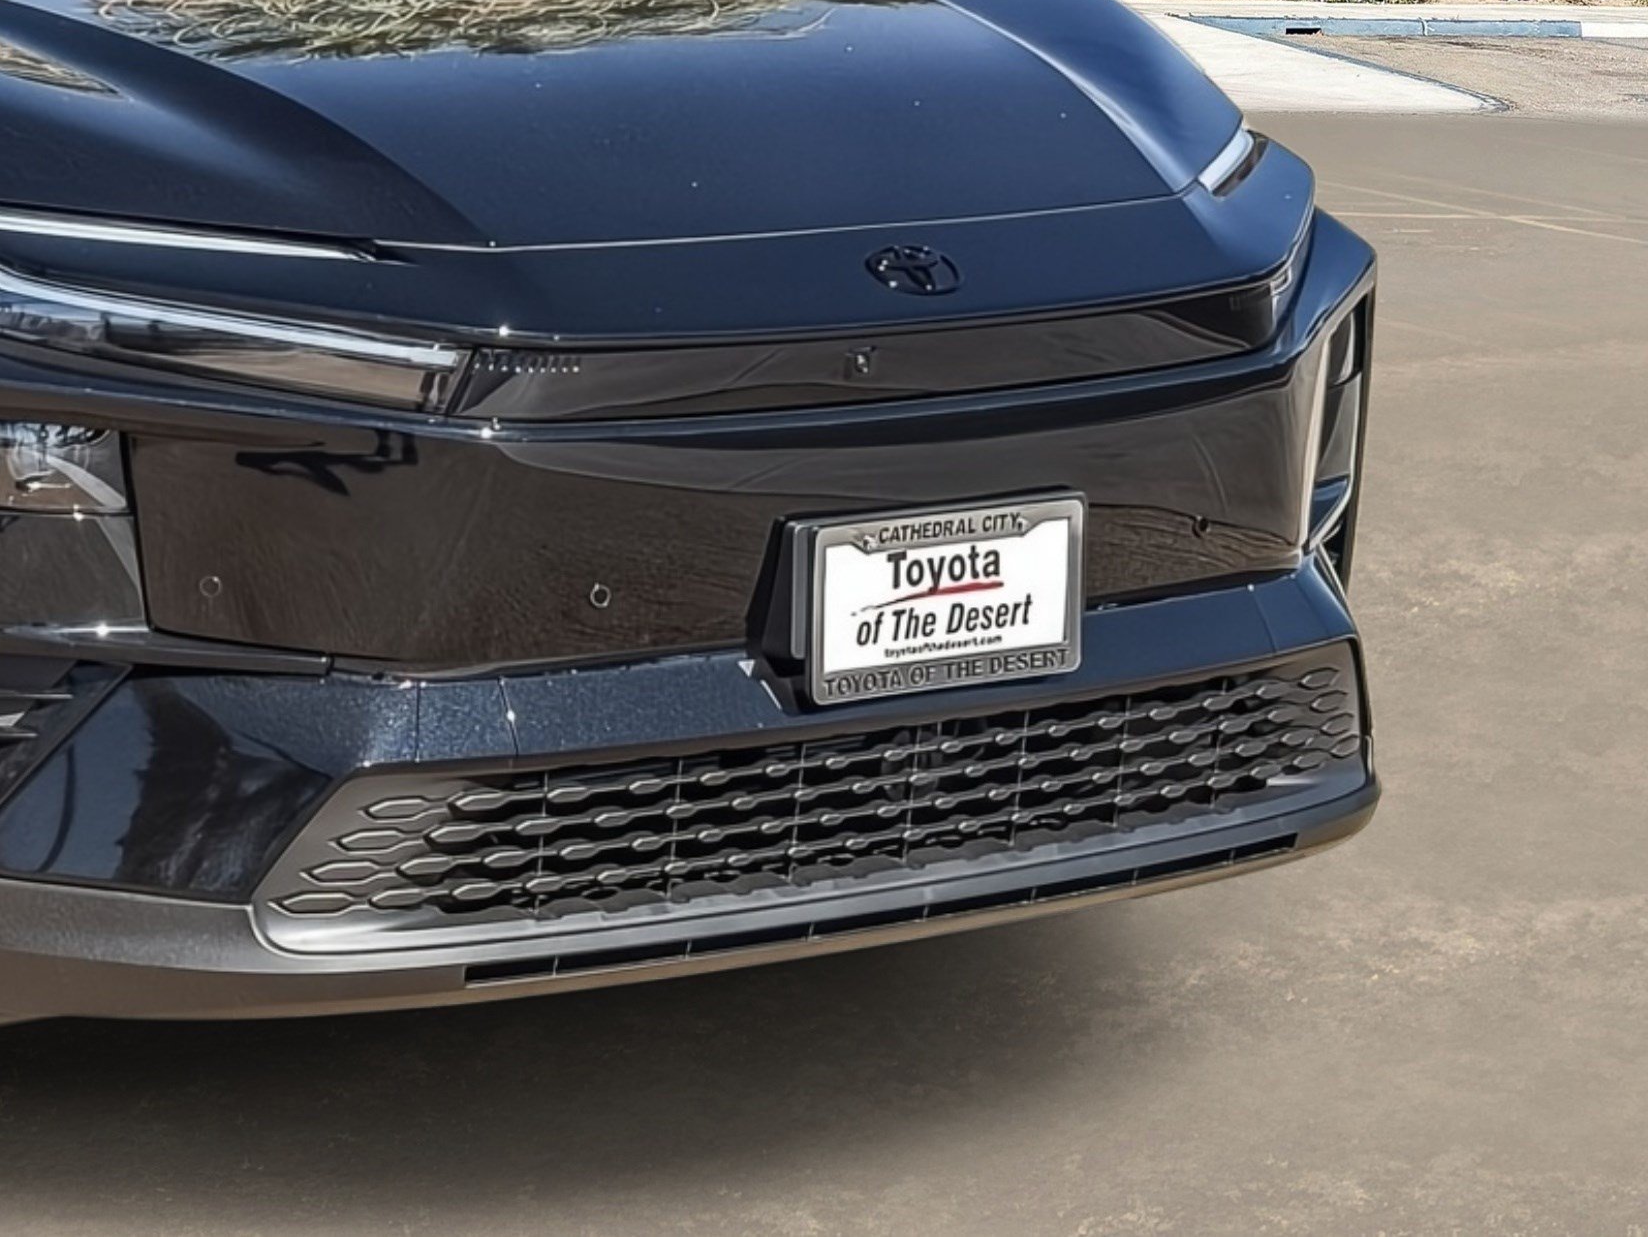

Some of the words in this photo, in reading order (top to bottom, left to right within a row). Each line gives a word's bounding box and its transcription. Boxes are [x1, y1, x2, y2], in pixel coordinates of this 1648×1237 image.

[878, 518, 977, 544] CATHEDRAL
[982, 512, 1020, 532] CITY
[886, 545, 1001, 594] Toyota
[856, 612, 884, 647] of
[891, 607, 936, 642] The
[946, 593, 1033, 635] Desert
[824, 669, 902, 697] TOYOTA
[910, 664, 937, 685] OF
[945, 659, 984, 680] THE
[989, 648, 1069, 674] DESERT
